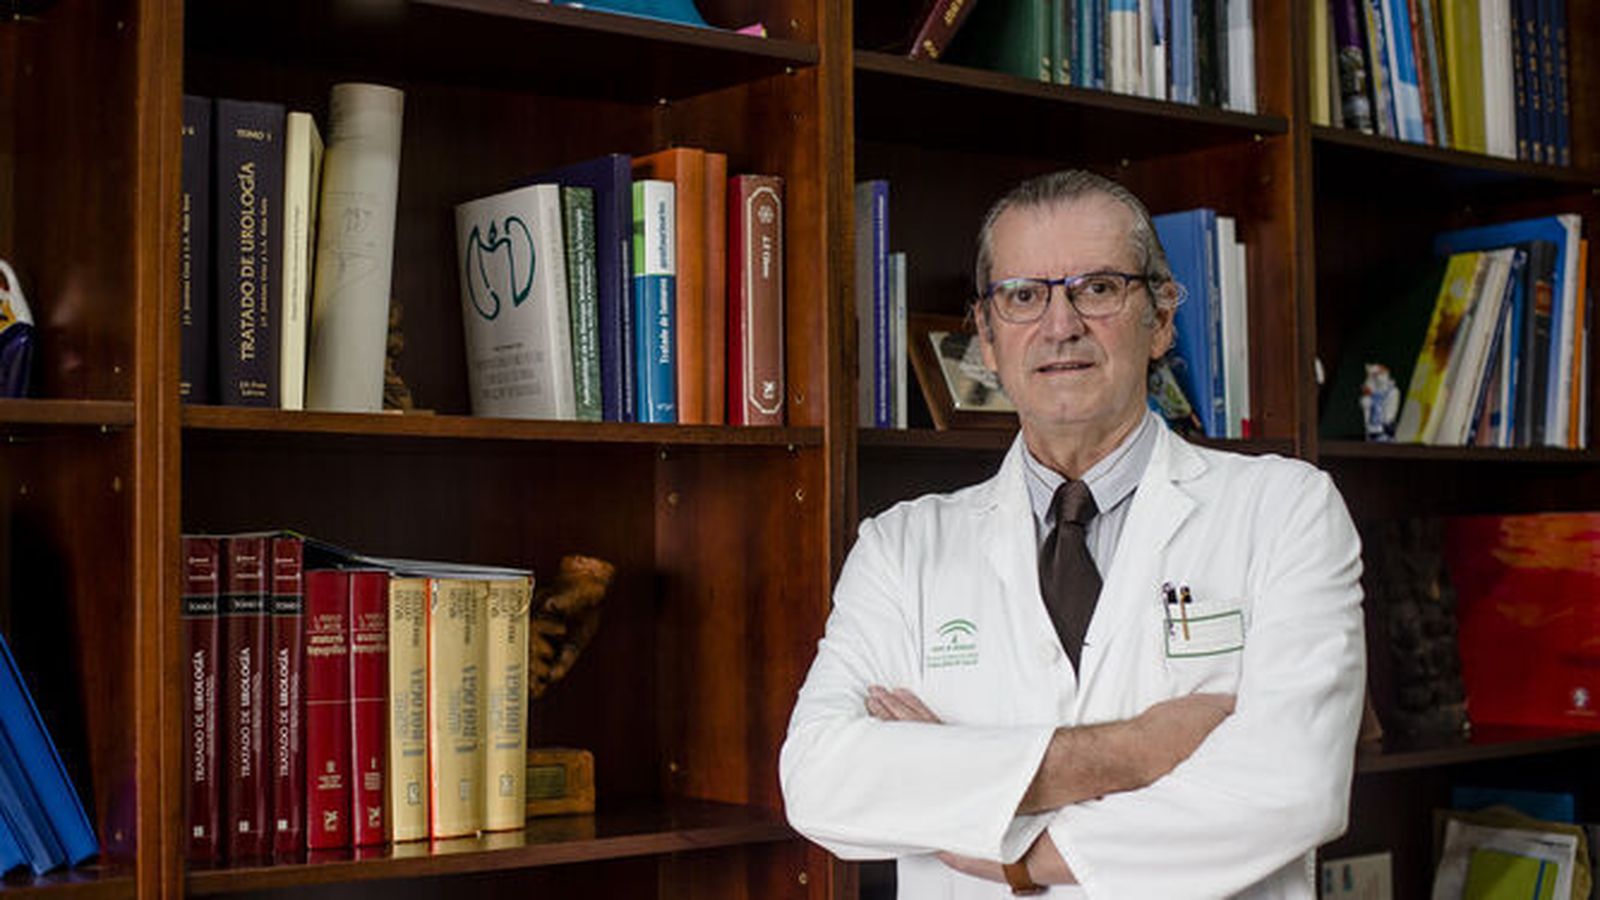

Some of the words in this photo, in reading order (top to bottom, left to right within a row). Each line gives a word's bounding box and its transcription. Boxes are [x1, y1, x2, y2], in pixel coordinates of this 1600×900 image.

[236, 162, 256, 252] UROLOGÍA
[239, 256, 255, 278] DE
[239, 282, 256, 361] TRATADO
[658, 329, 670, 364] Tratado
[193, 650, 205, 712] UROLOGÍA
[239, 647, 251, 707] UROLOGÍA
[277, 648, 290, 707] UROLOGÍA
[194, 713, 205, 728] DE
[240, 710, 251, 725] DE
[278, 710, 290, 724] DE
[194, 729, 205, 782] TRATADO
[240, 726, 251, 778] TRATADO
[278, 725, 290, 777] TRATADO
